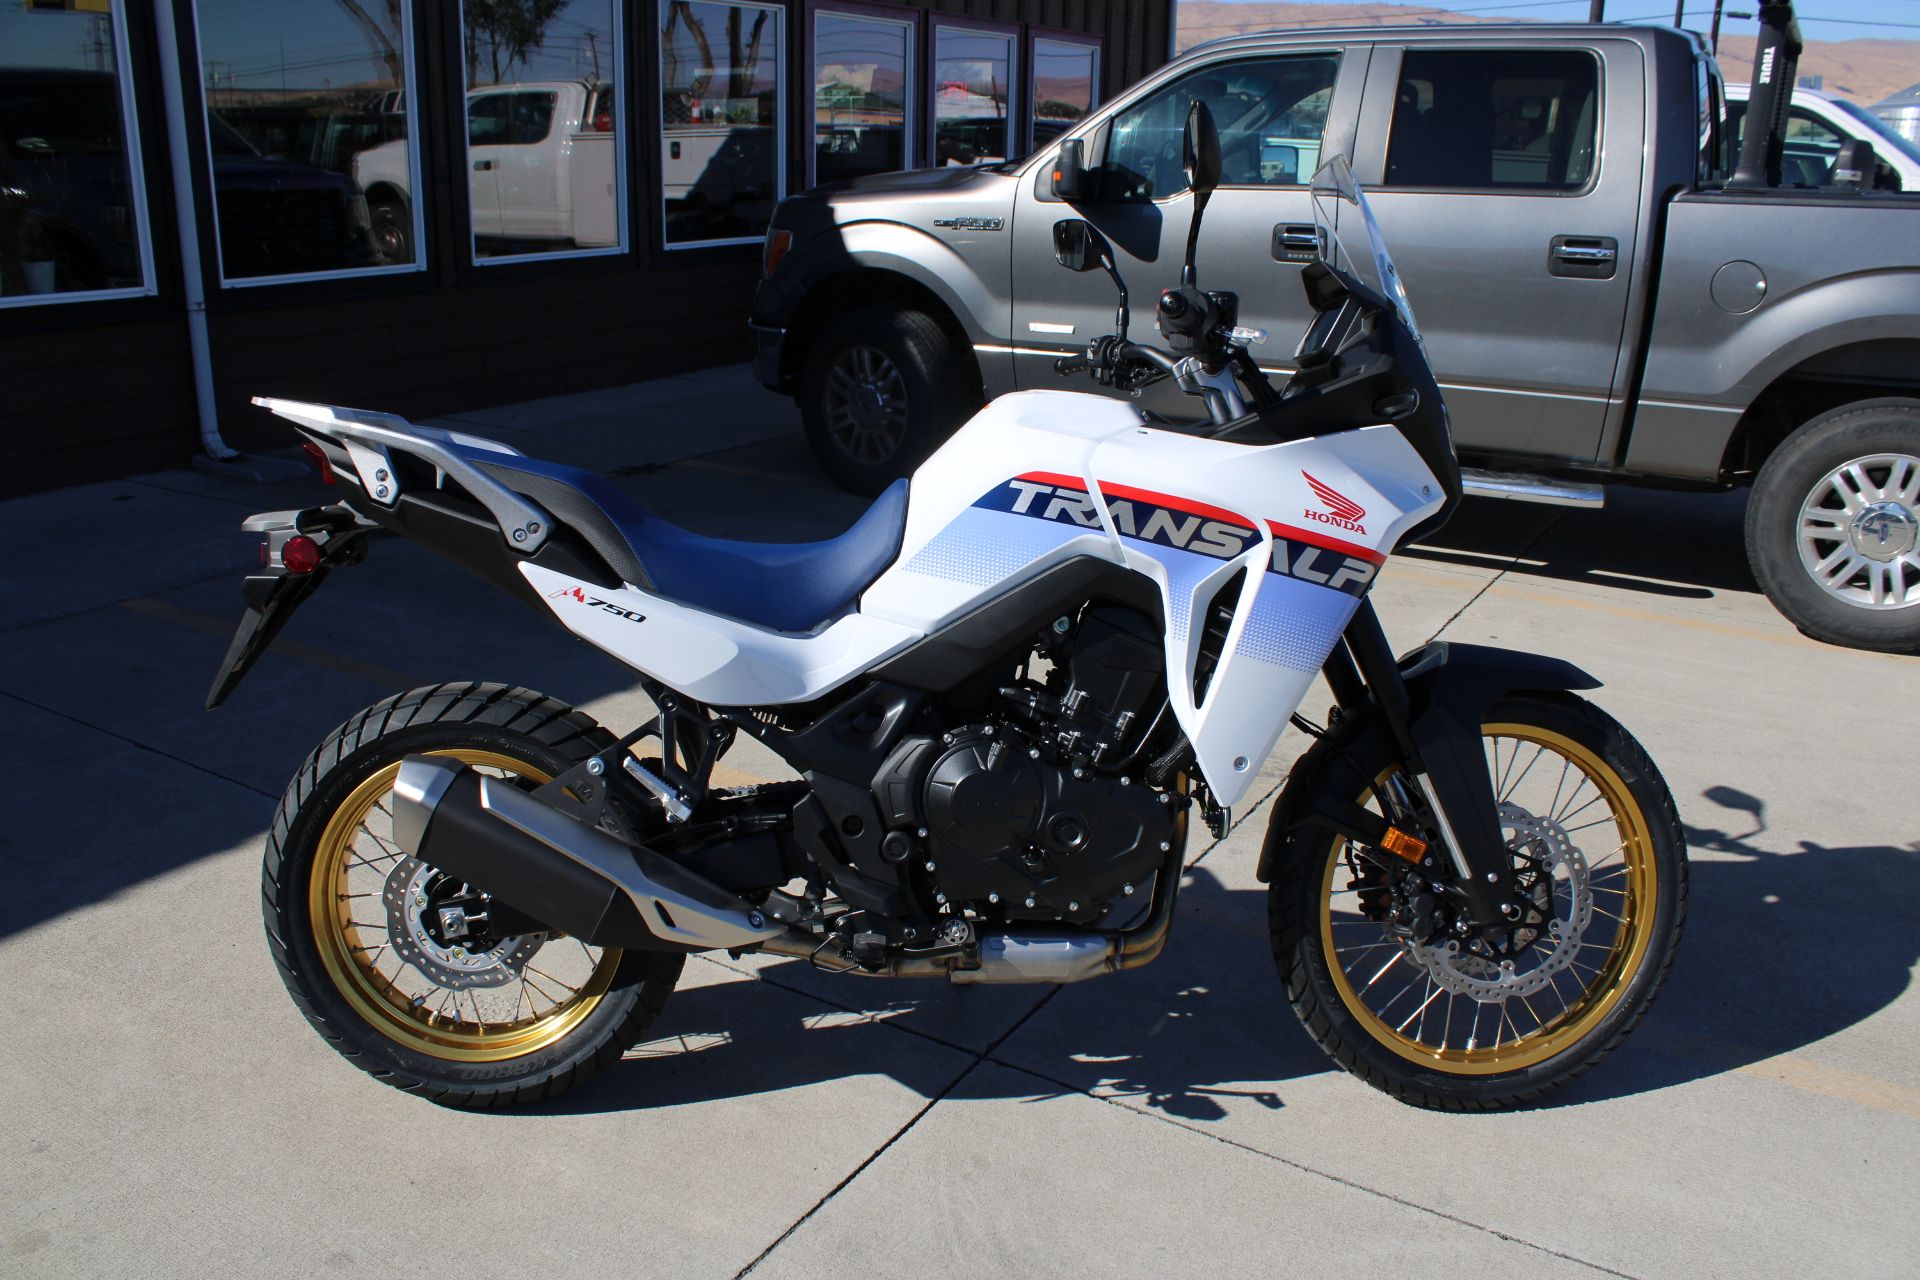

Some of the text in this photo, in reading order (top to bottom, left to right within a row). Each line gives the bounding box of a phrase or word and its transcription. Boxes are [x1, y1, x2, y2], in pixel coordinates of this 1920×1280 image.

[1759, 46, 1776, 84] THULE
[1303, 508, 1367, 536] HONDA
[586, 596, 647, 623] 750
